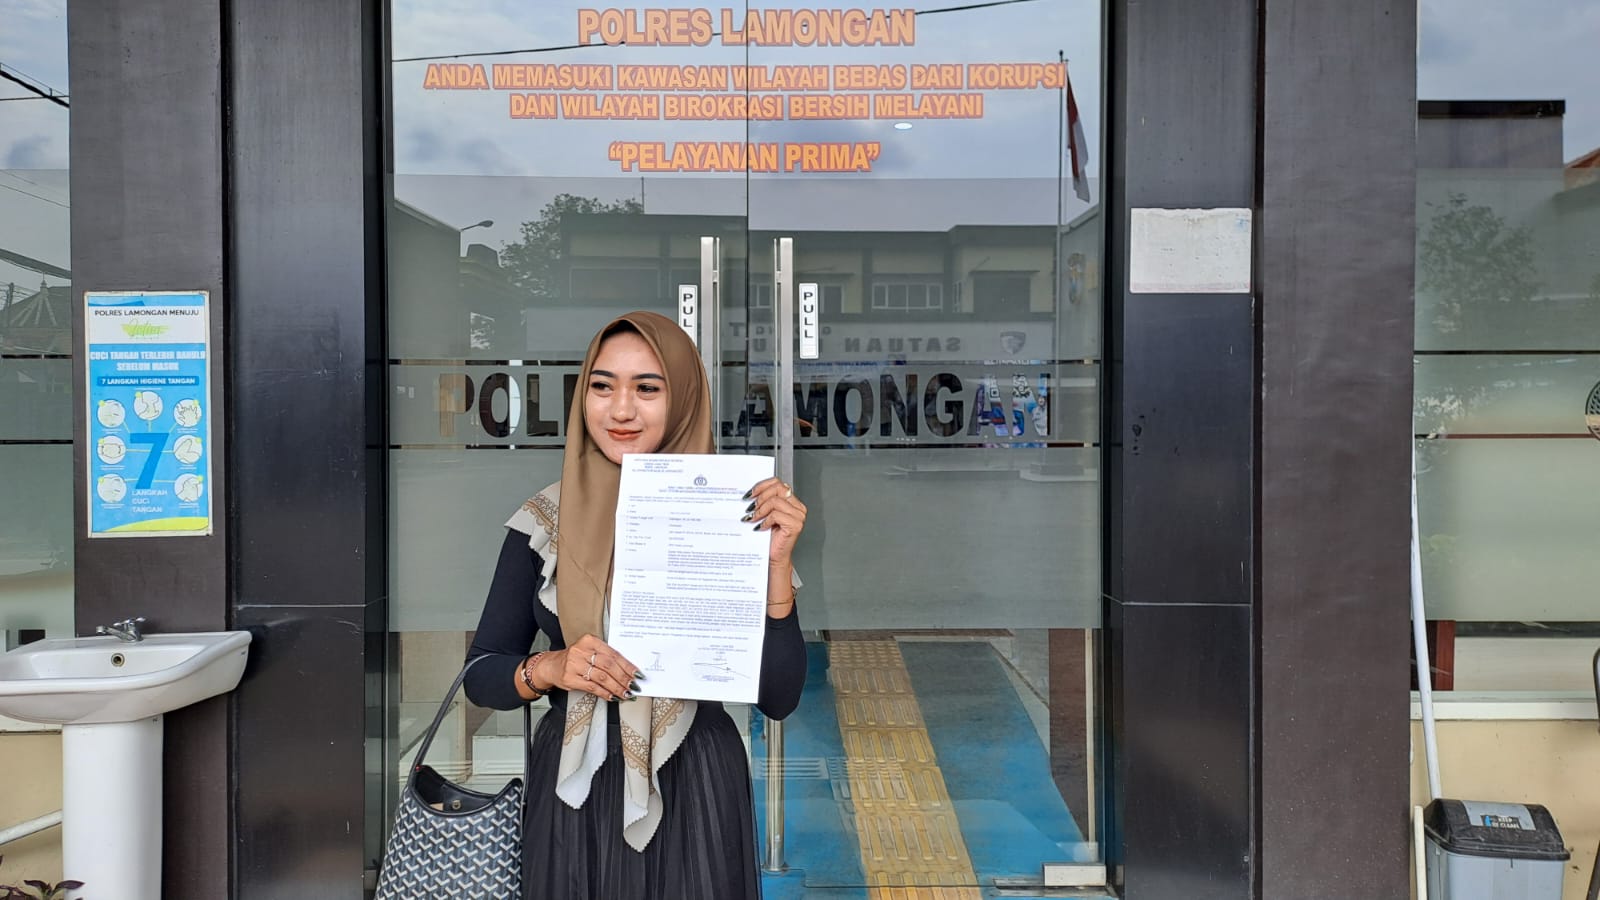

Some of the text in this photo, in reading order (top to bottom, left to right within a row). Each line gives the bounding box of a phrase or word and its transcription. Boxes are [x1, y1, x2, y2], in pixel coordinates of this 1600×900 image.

[577, 8, 915, 46] POLRES LAMONGAN
[423, 63, 1066, 91] ANDA MEMASUKI KAWASAN WILAYAH BEBAS DARI KORUPSI
[510, 93, 984, 120] DAN WILAYAH BIROKRASI BERSIH MELAYANI
[608, 141, 881, 172] “PELAYANAN PRIMA”
[683, 293, 693, 328] PUL
[803, 292, 814, 338] PULL
[90, 351, 109, 360] CUCI
[438, 373, 1050, 438] POL AMONGAN
[130, 433, 170, 490] 7
